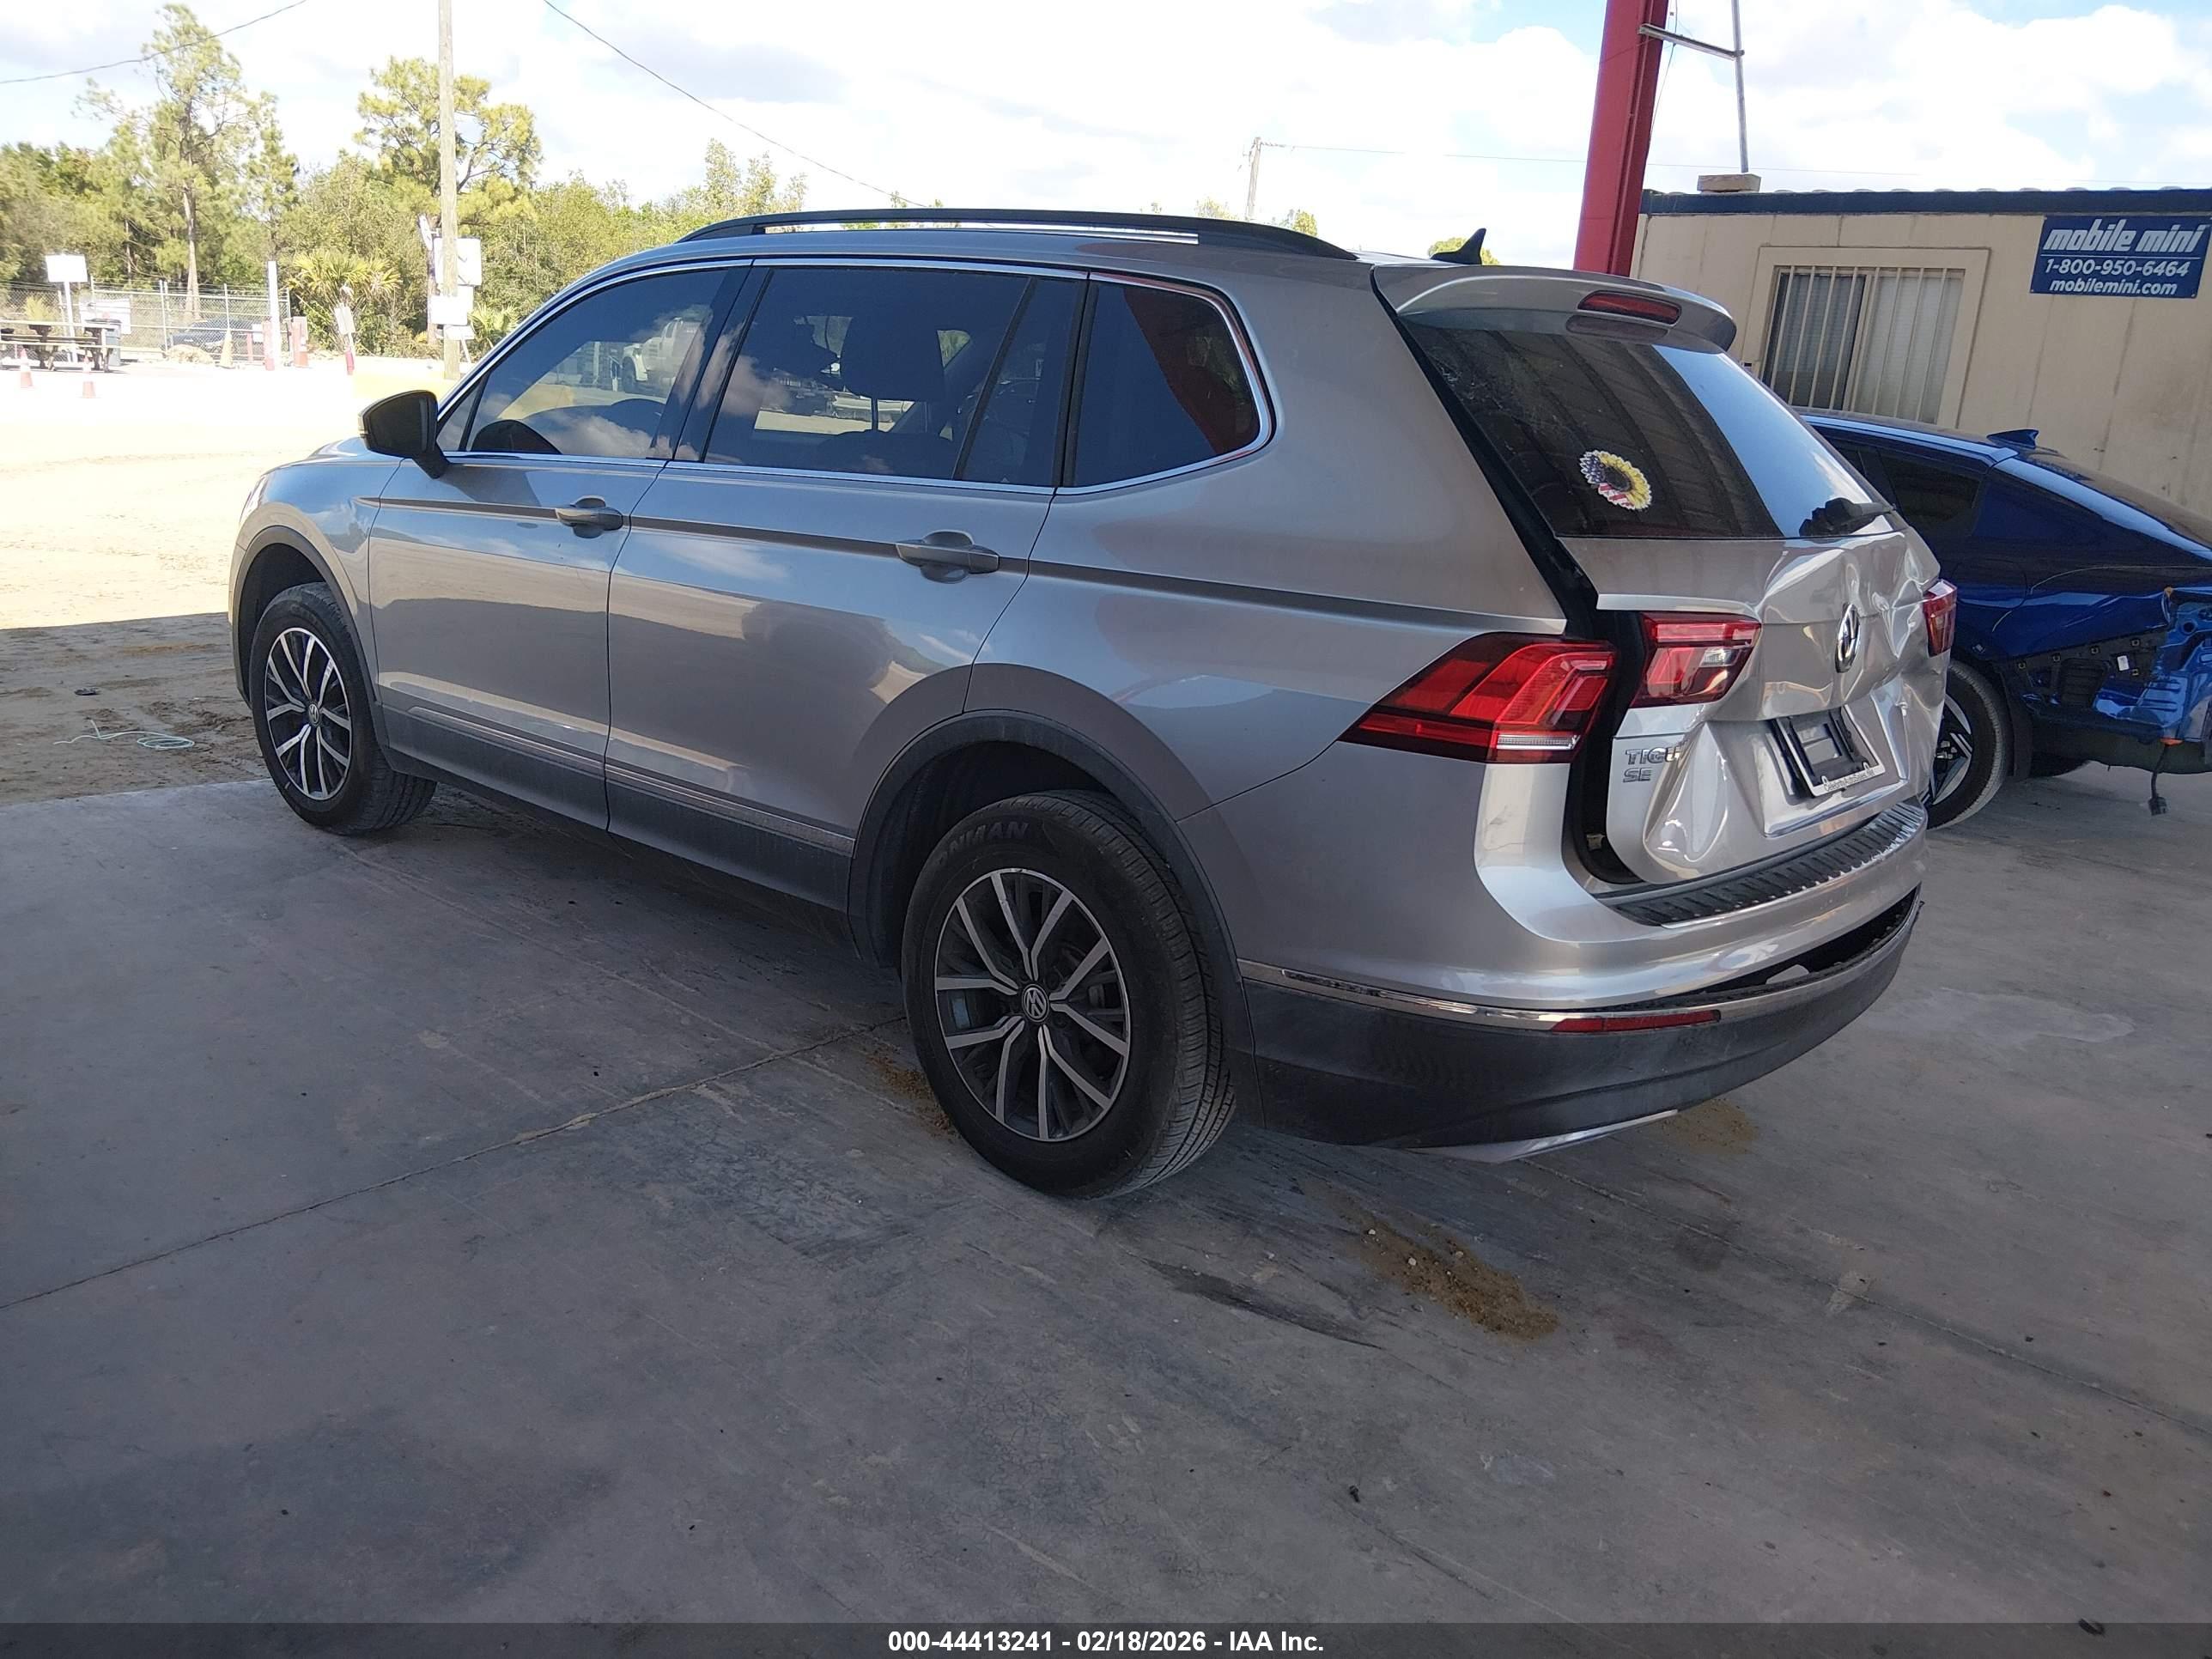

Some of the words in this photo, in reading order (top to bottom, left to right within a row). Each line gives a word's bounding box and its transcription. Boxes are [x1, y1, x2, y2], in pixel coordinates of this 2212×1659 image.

[2043, 219, 2136, 251] mobile
[2136, 224, 2205, 252] mini
[2045, 258, 2191, 276] 1-800-950-6464
[2049, 277, 2178, 295] mobilemini.com
[1626, 746, 1681, 765] TIGU
[1623, 767, 1652, 782] SE
